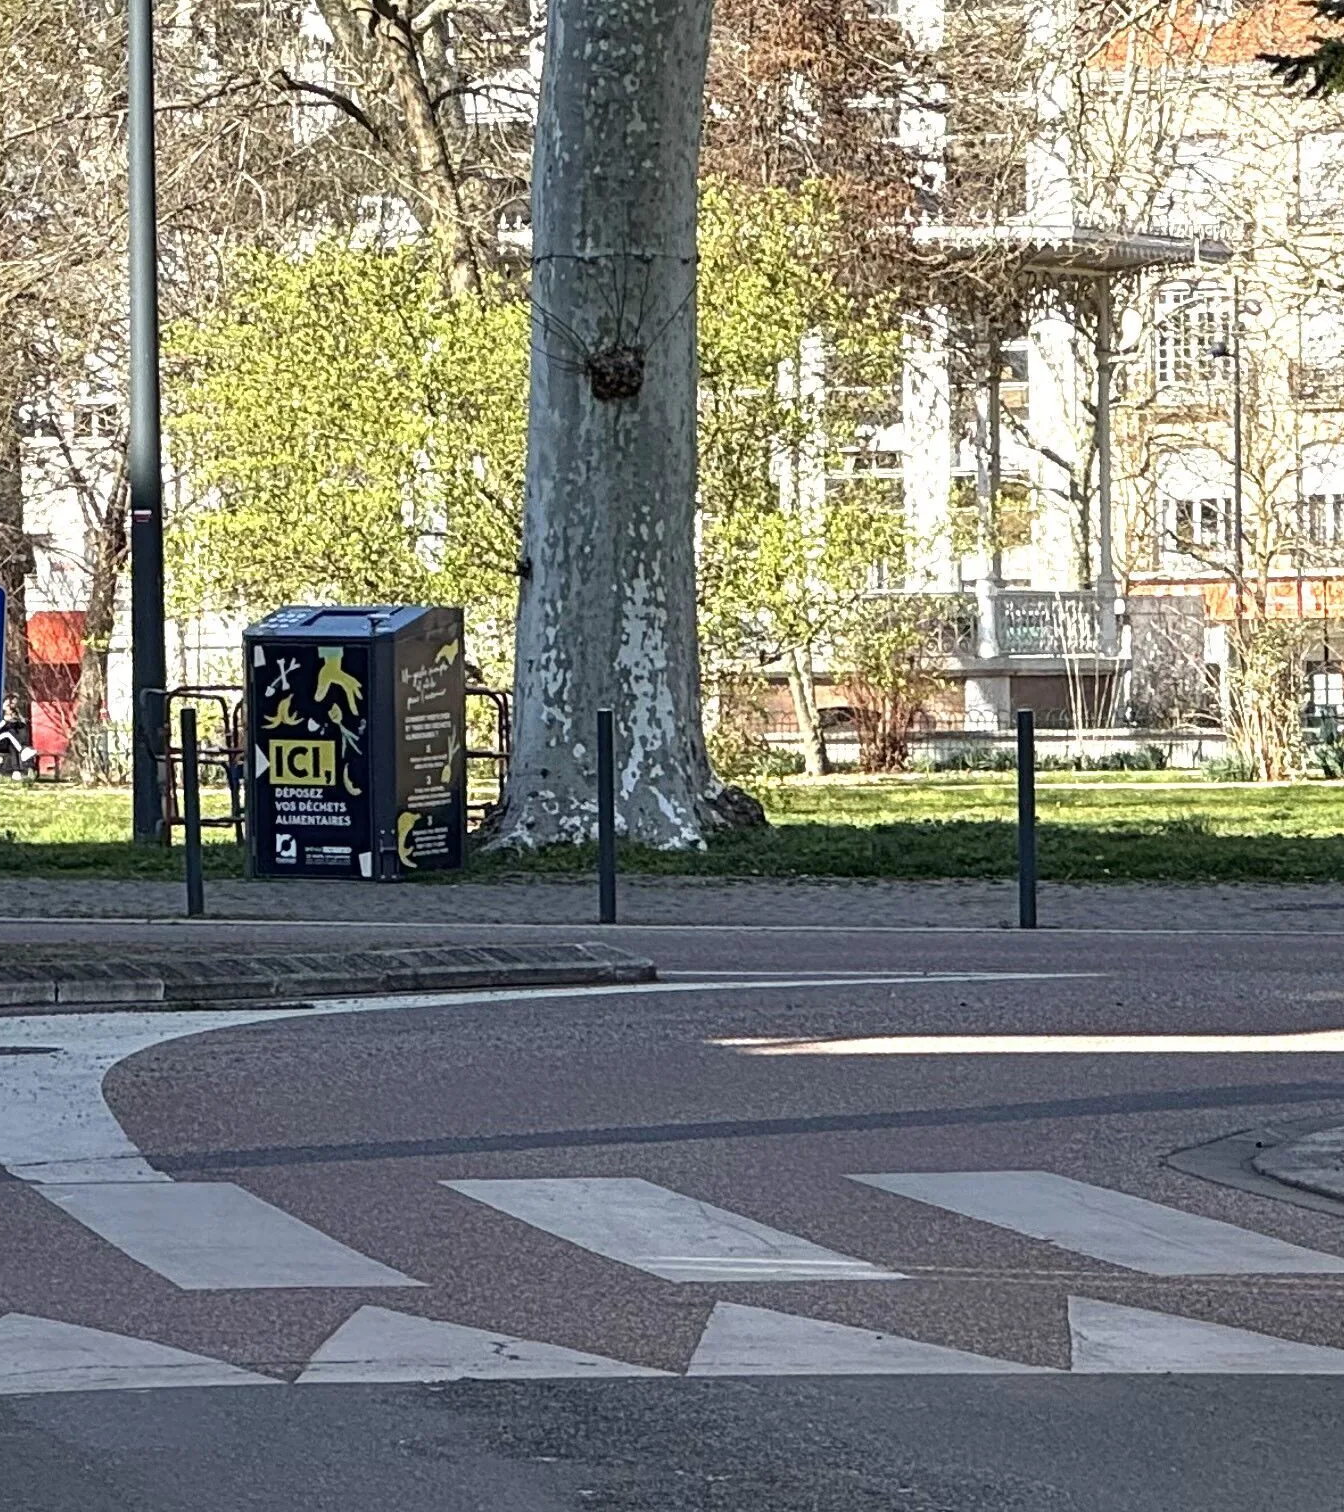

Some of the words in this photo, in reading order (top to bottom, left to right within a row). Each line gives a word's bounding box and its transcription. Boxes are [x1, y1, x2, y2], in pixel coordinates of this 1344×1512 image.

[274, 787, 324, 799] DÉPOSEZ
[274, 801, 297, 812] VOS
[298, 800, 348, 813] DÉCHETS
[275, 814, 352, 826] ALIMENTAIRES
